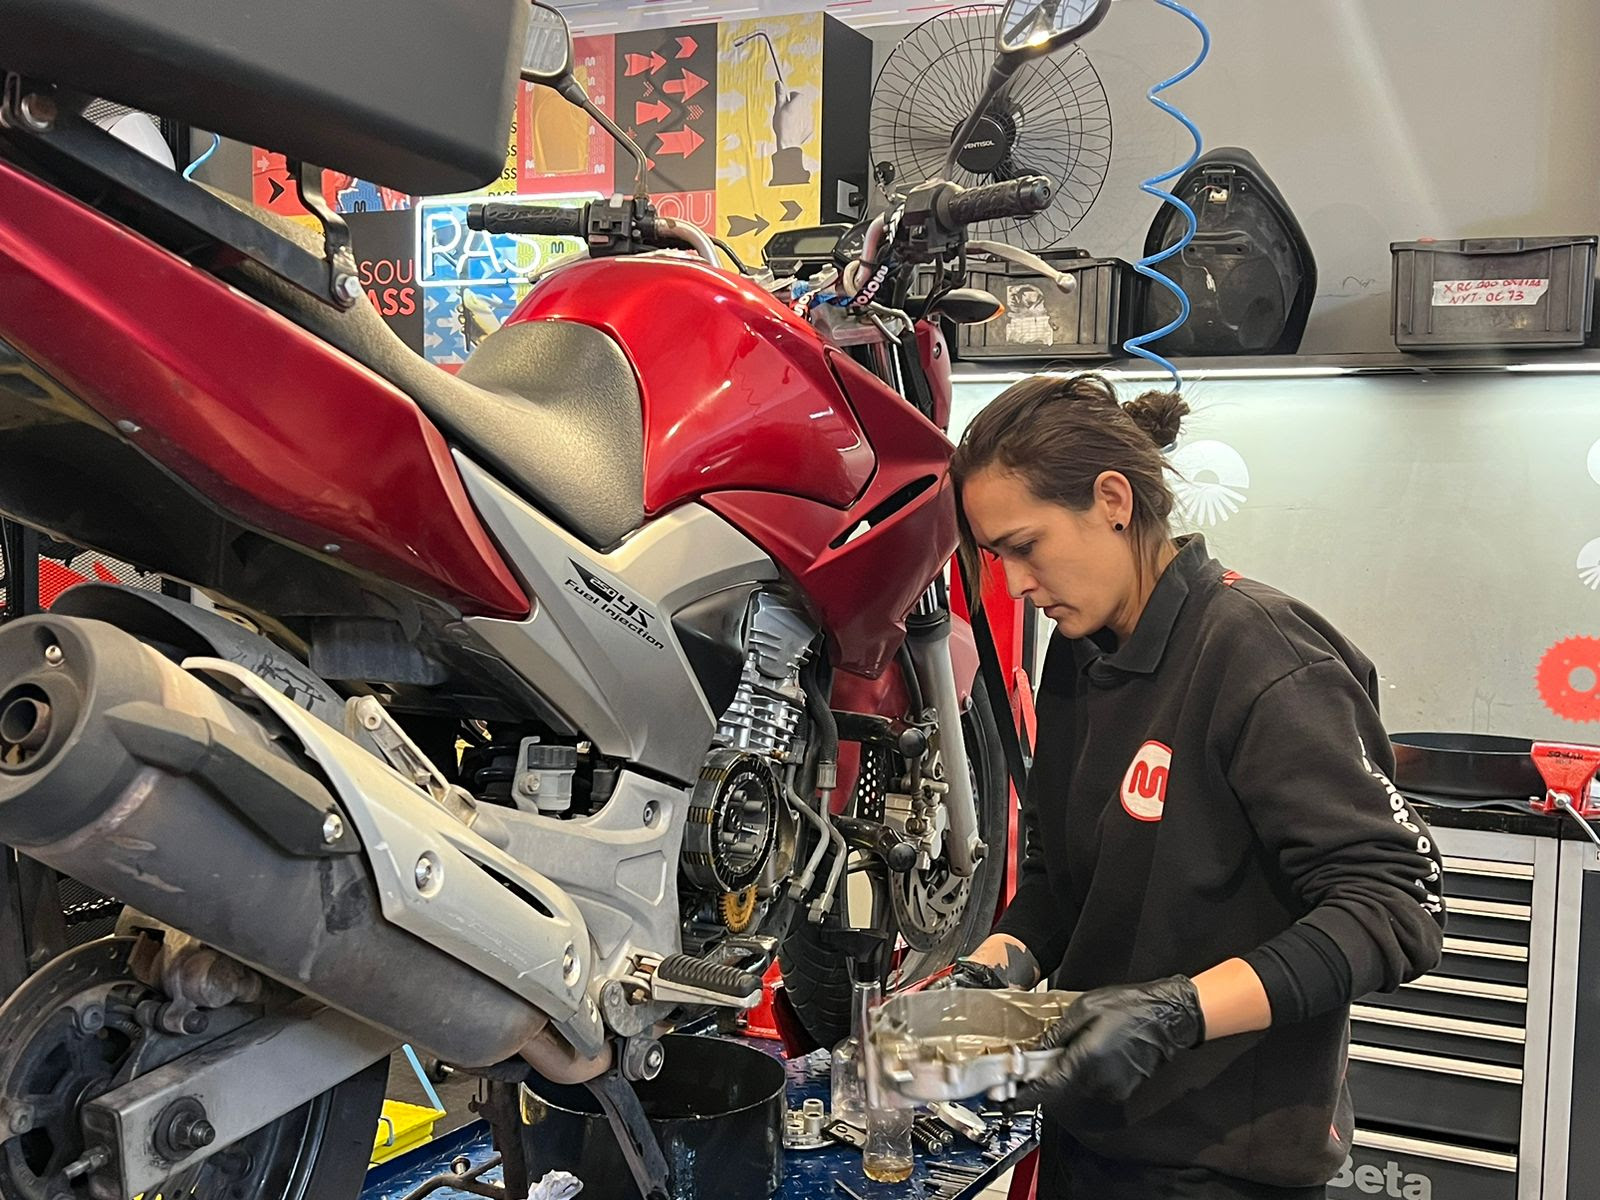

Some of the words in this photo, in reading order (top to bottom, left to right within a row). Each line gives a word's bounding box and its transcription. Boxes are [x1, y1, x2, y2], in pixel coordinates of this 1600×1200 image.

[655, 192, 712, 229] OU
[359, 258, 414, 286] SOU
[367, 287, 417, 317] ASS
[564, 578, 601, 605] Fuel
[600, 603, 665, 650] Injection
[1325, 1154, 1432, 1200] Beta
